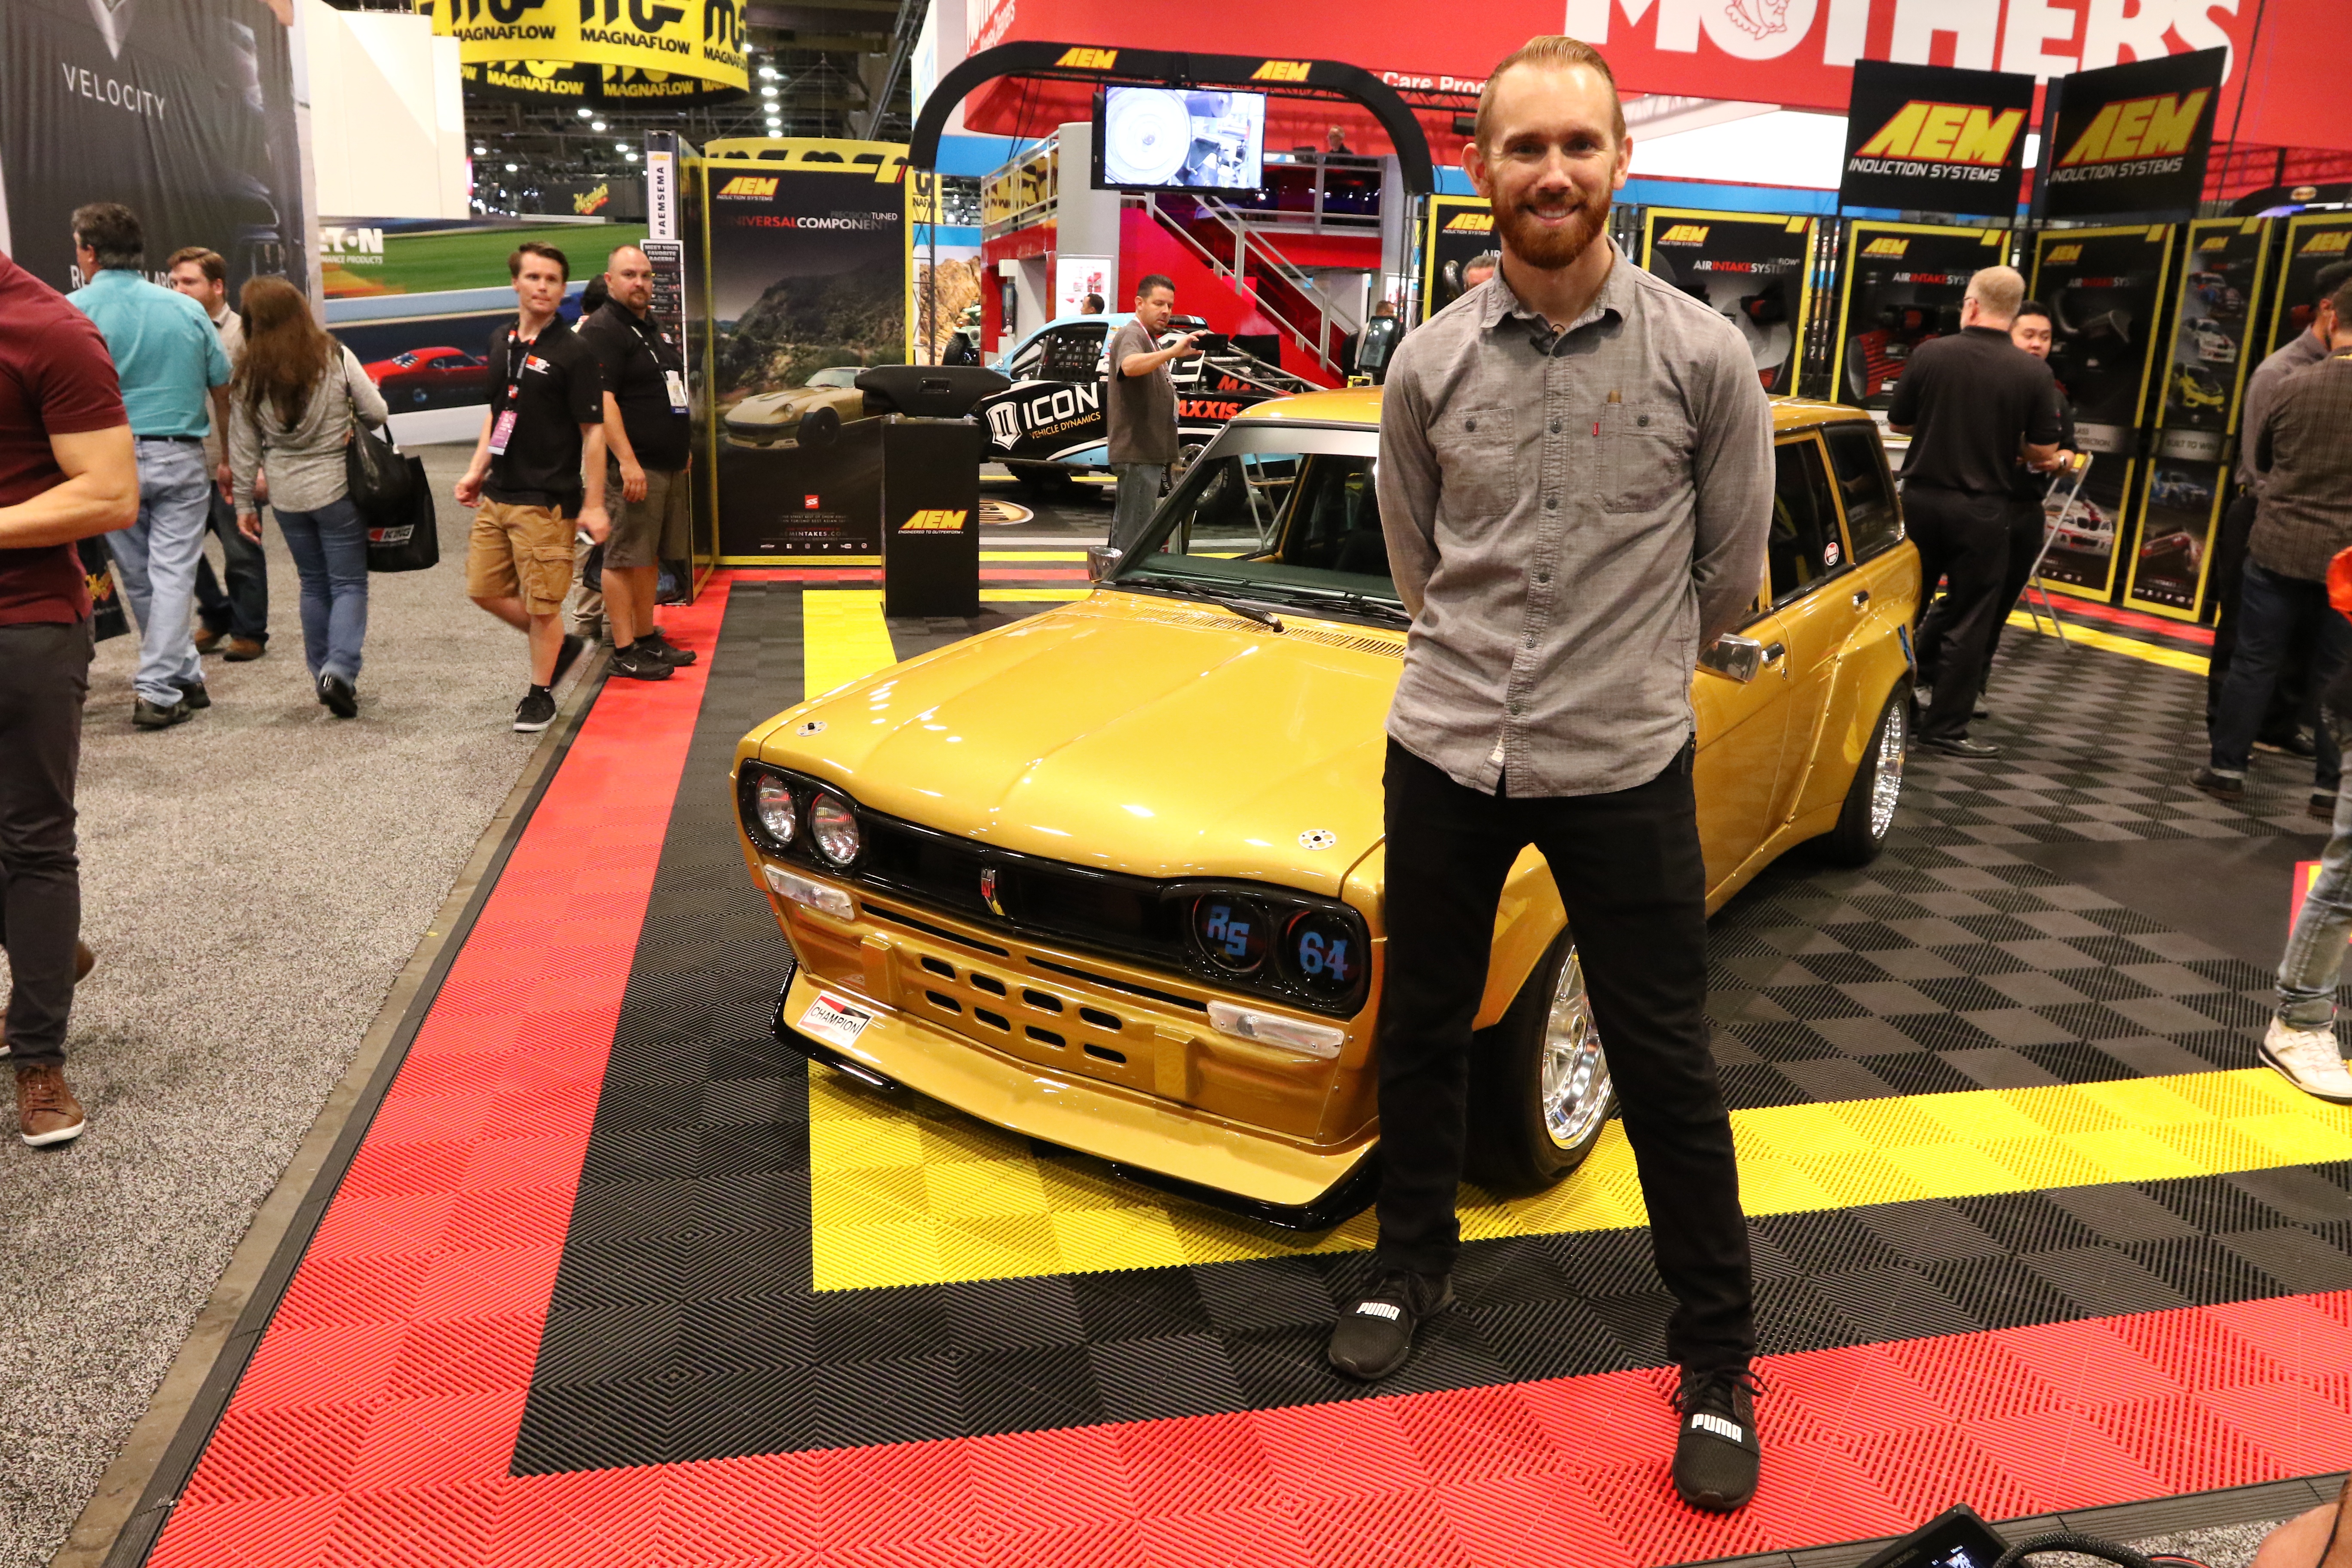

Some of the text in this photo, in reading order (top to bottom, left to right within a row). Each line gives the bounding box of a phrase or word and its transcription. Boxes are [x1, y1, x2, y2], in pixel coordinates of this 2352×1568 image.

[453, 26, 556, 41] MAGNAFLOW
[581, 28, 690, 55] MAGNAFLOW
[1054, 47, 1119, 70] AEM
[487, 70, 584, 95] MAGNAFLOW
[1250, 60, 1312, 83] AEM
[62, 62, 165, 120] VELOCITY
[603, 80, 694, 97] MAGNAFLOW
[1854, 99, 2028, 167] AEM
[2057, 87, 2213, 168] AEM
[1849, 158, 2001, 183] INDUCTION SYSTEMS
[2051, 157, 2184, 183] INDUCTION SYSTEMS
[717, 176, 781, 196] AEM
[656, 166, 667, 236] #AEMSEMA
[1444, 212, 1495, 231] AEM
[1659, 224, 1711, 243] AEM
[1862, 237, 1911, 255] AEM
[346, 255, 383, 264] PRODUCTS
[1023, 382, 1099, 430] ICON
[1178, 399, 1240, 420] AXXIS
[1029, 411, 1101, 440] VEHICLE DYNAMICS
[899, 509, 968, 530] AEM
[1207, 905, 1250, 956] RS
[1299, 931, 1349, 981] 64
[811, 1007, 861, 1034] CHAMPION
[1357, 1301, 1400, 1321] PUMA
[1691, 1412, 1743, 1443] PUMA
